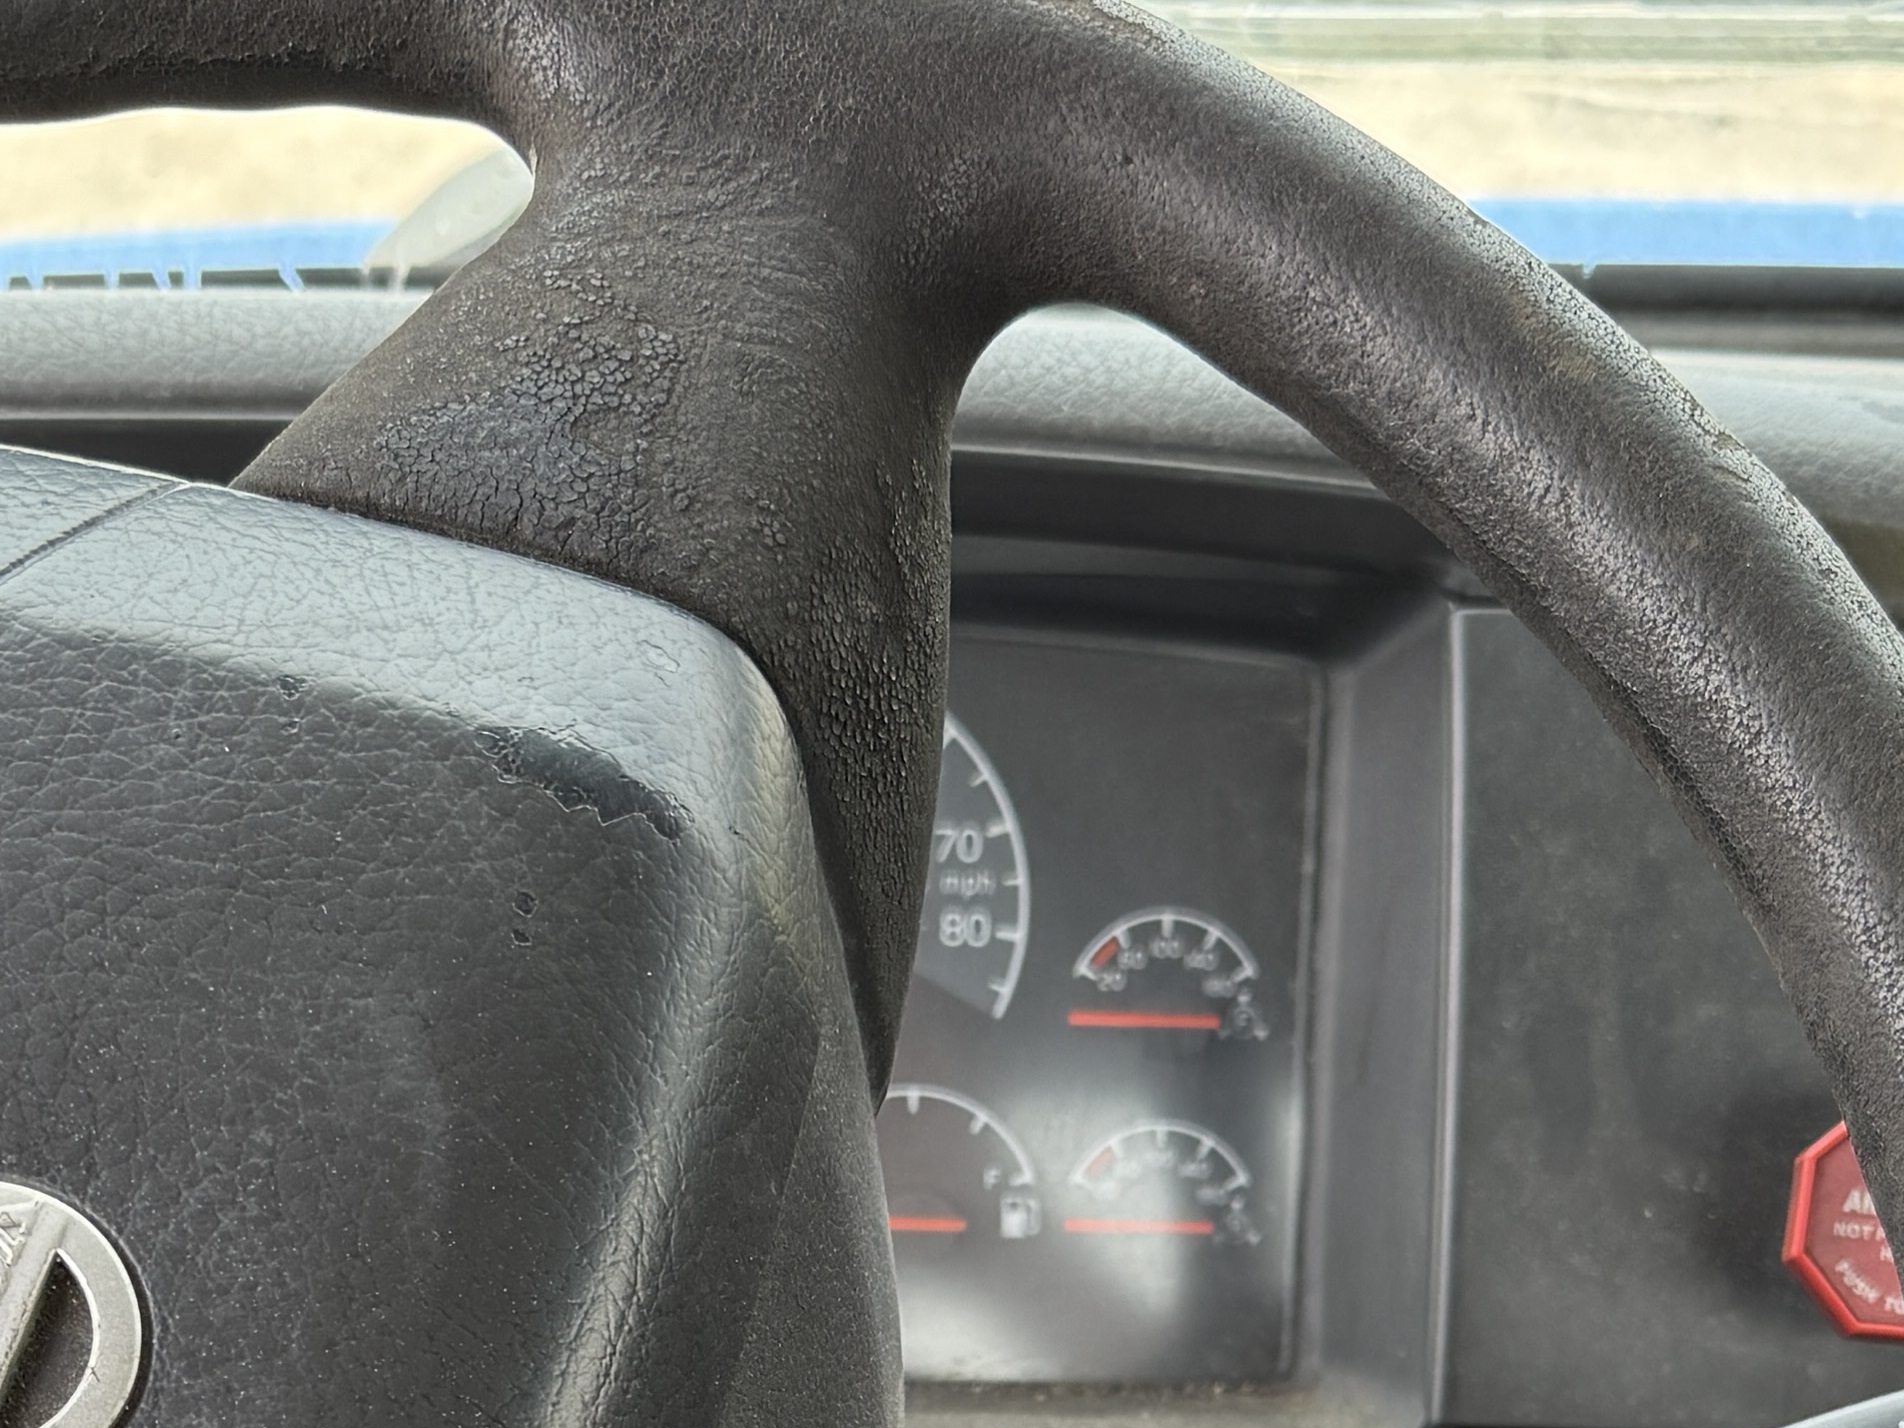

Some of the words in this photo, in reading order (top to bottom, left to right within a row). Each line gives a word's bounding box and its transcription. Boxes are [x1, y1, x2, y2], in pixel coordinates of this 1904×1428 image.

[934, 823, 984, 864] 70
[939, 908, 992, 947] 80
[1833, 1222, 1874, 1241] NOT
[1834, 1258, 1880, 1305] PUSH
